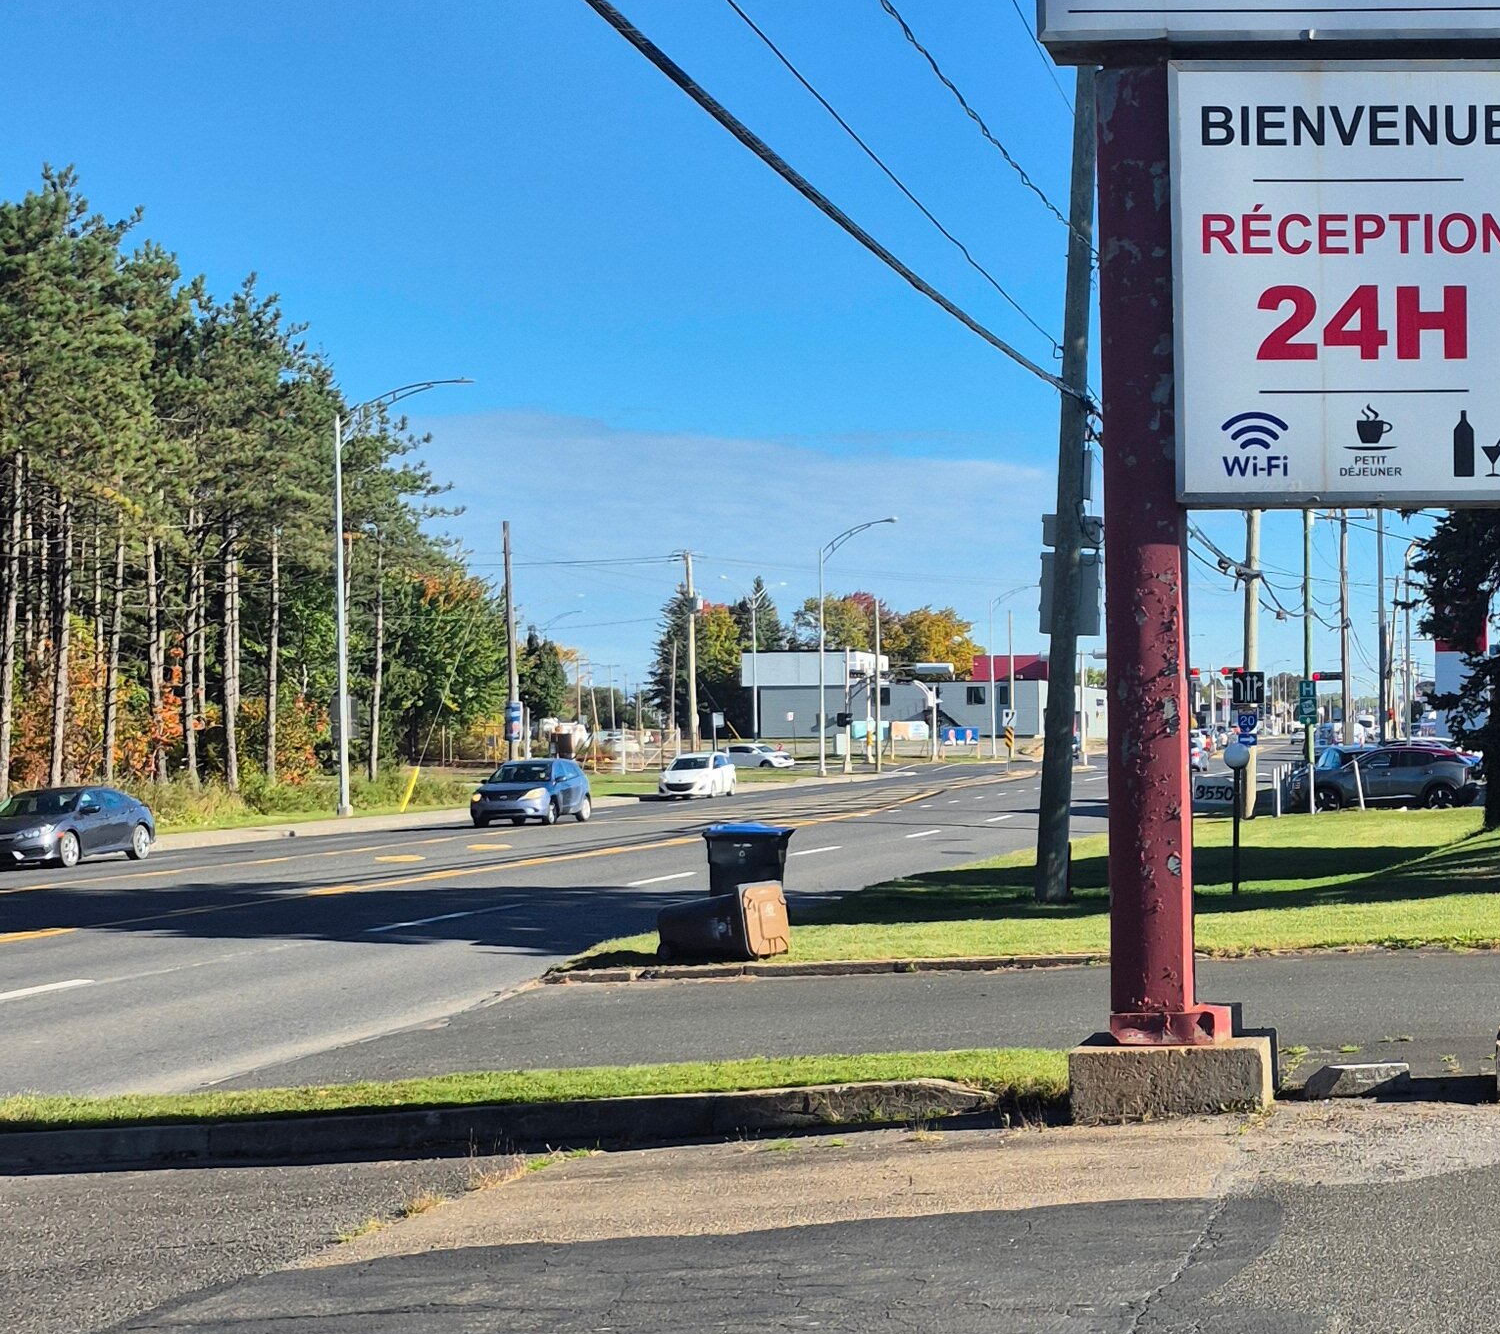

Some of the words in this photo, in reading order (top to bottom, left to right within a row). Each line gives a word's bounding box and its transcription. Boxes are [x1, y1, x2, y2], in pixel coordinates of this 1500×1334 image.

[1256, 285, 1468, 361] 24H
[1222, 455, 1289, 478] Wi-Fi
[1354, 455, 1387, 465] PETIT
[1339, 465, 1402, 477] DÉJEUNER
[1302, 682, 1314, 696] H
[1240, 715, 1255, 726] 20
[1194, 784, 1234, 801] 3550
